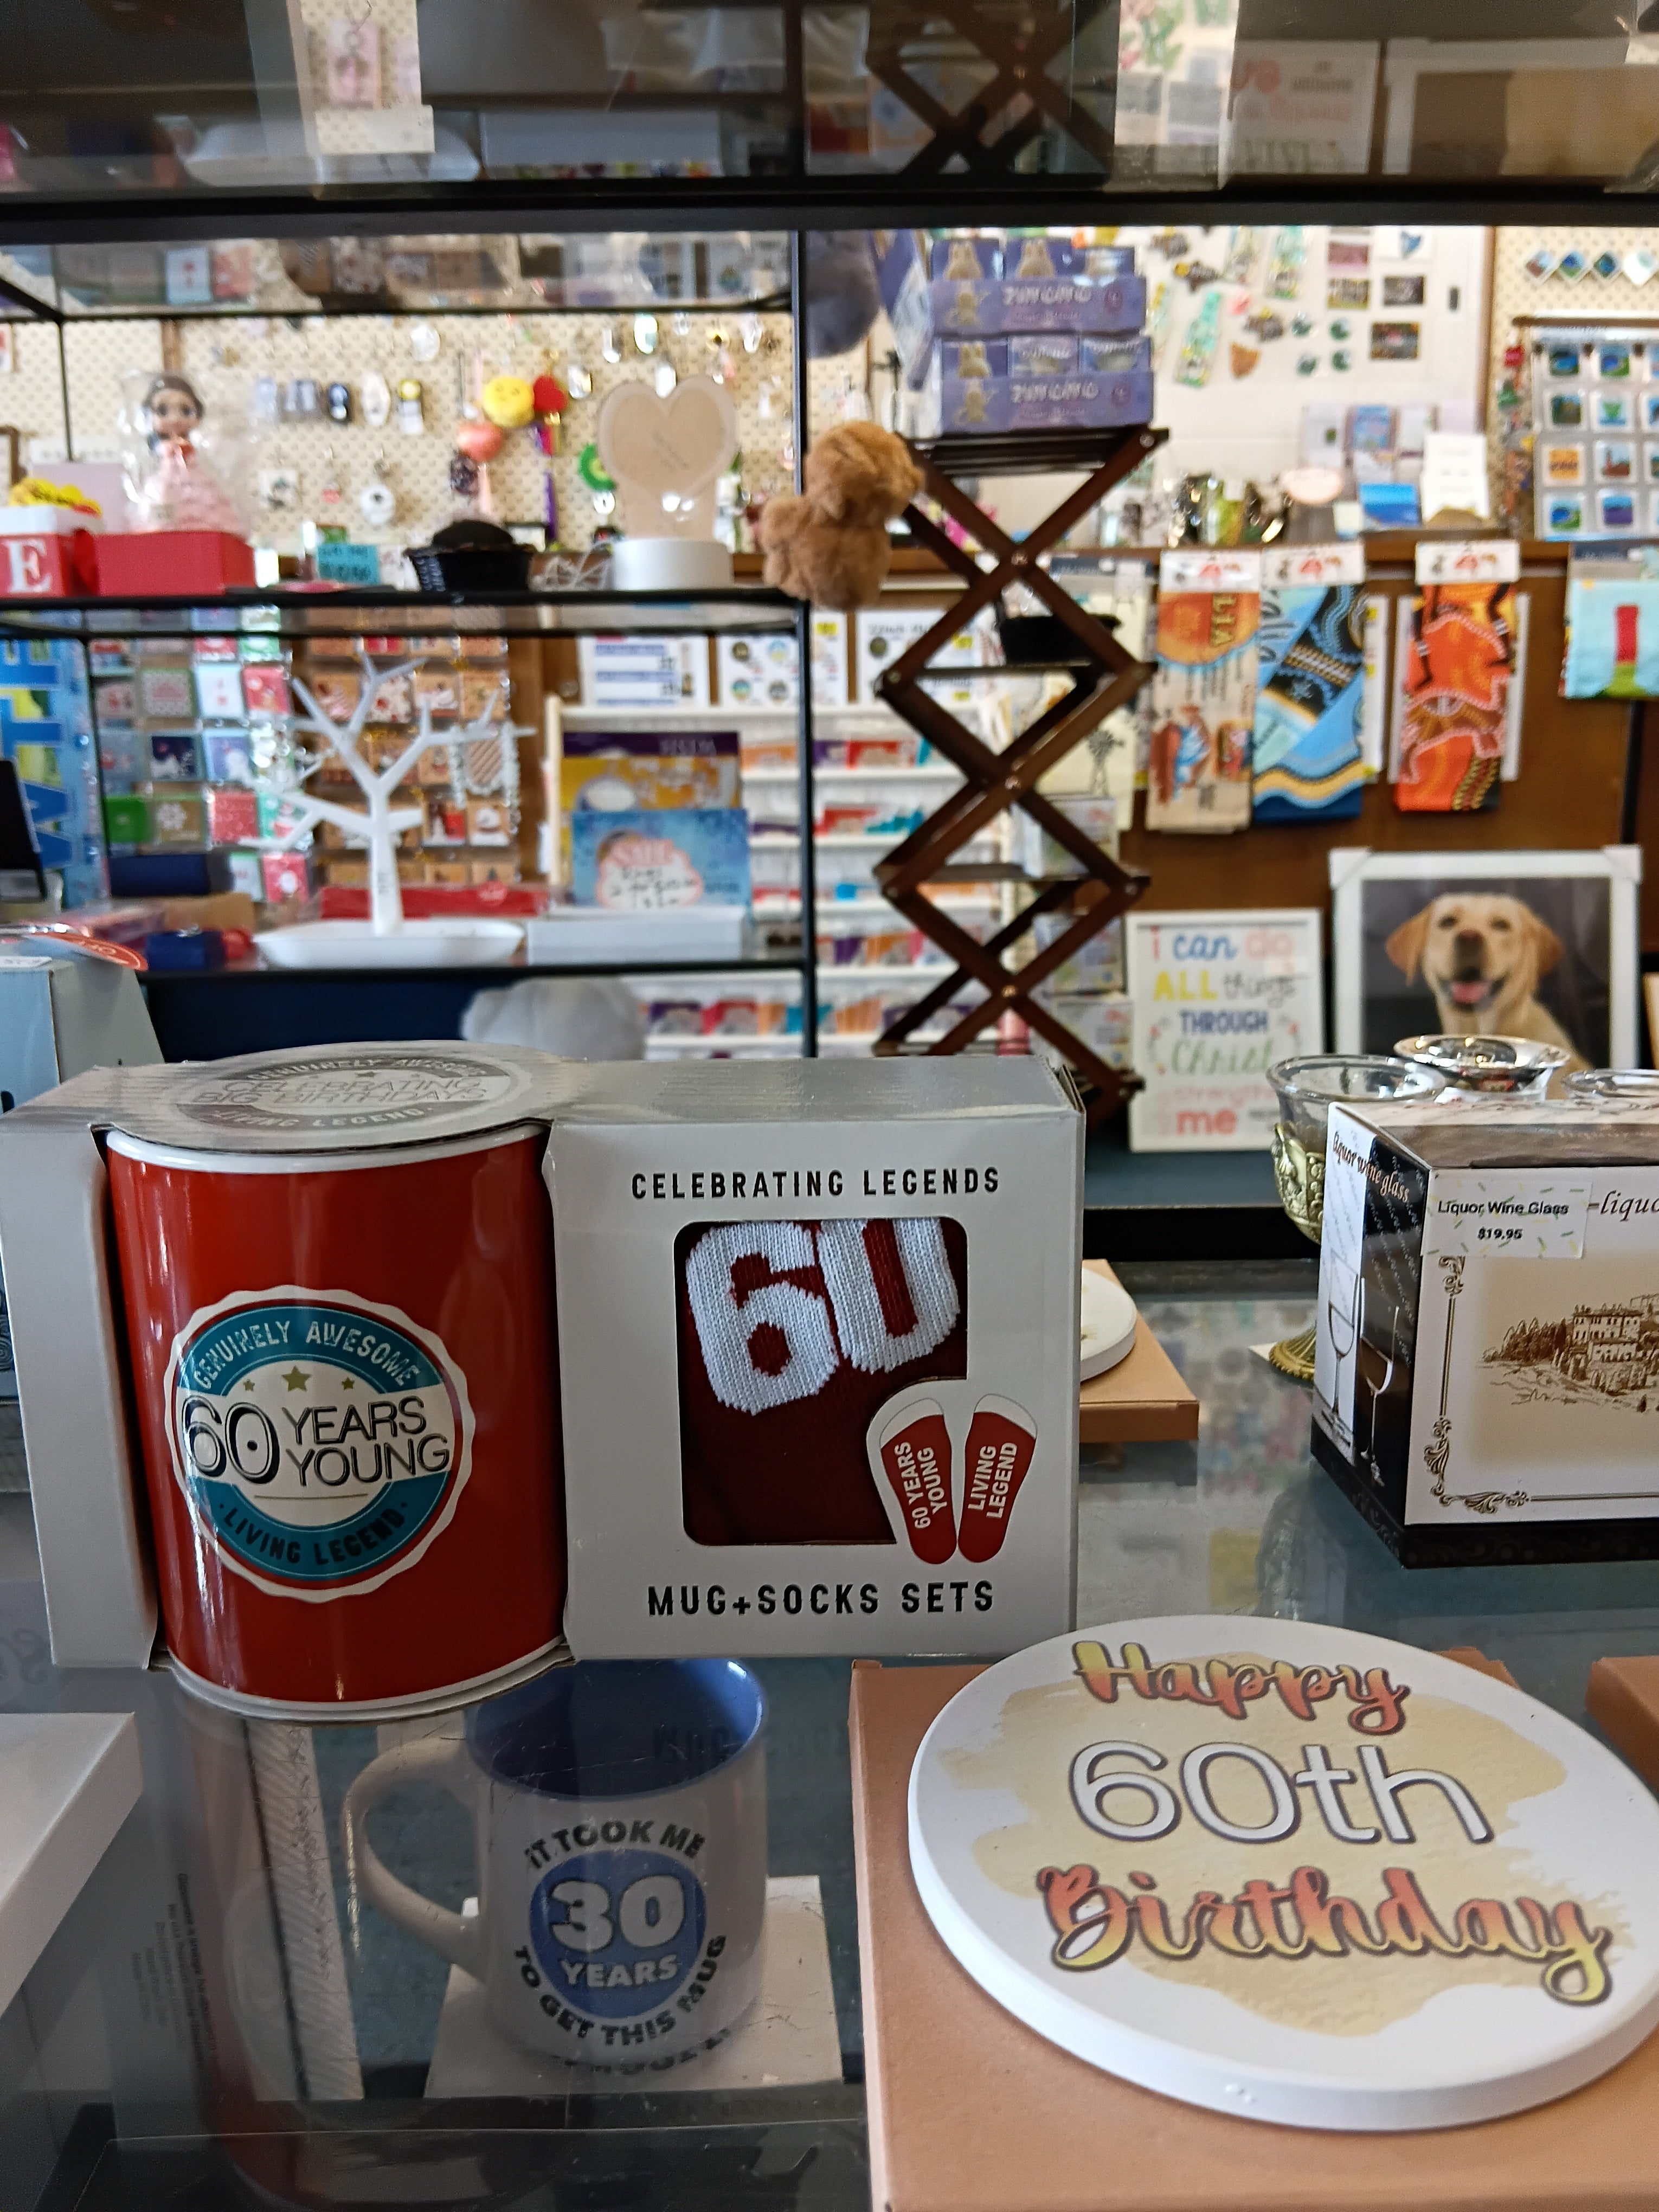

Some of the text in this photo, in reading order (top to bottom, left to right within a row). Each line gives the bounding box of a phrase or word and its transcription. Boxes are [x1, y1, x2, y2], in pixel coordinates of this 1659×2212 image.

[1172, 934, 1238, 961] can
[1153, 970, 1219, 1001] ALL
[1180, 1010, 1269, 1035] THROUGH
[1176, 1108, 1238, 1135] me
[631, 1167, 1001, 1201] CELEBRATING LEGENDS
[1357, 1156, 1382, 1185] wine
[1380, 1170, 1410, 1204] glass
[1438, 1200, 1569, 1216] Liquor Wine Glass
[1477, 1227, 1523, 1241] $19.95
[685, 1216, 962, 1417] 60
[192, 1320, 421, 1390] GENUINELY AWESOME
[181, 1394, 427, 1485] 60 YEARS
[285, 1432, 451, 1487] YOUNG
[893, 1441, 932, 1529] 60 YEARS
[917, 1446, 948, 1515] YOUNG
[967, 1445, 996, 1510] LIVING
[986, 1442, 1018, 1519] LEGEND
[223, 1506, 407, 1565] LIVING LEGEND
[648, 1580, 995, 1619] MUG+SOCKS SETS
[1071, 1638, 1411, 1736] Happy
[1067, 1739, 1495, 1846] 60th
[551, 1819, 654, 1853] TOOK
[660, 1822, 706, 1860] ME
[548, 1873, 687, 1952] 30
[1036, 1862, 1616, 2010] Birthday
[514, 1934, 728, 2047] TO GET THIS MUG
[558, 1954, 680, 1989] YEARS
